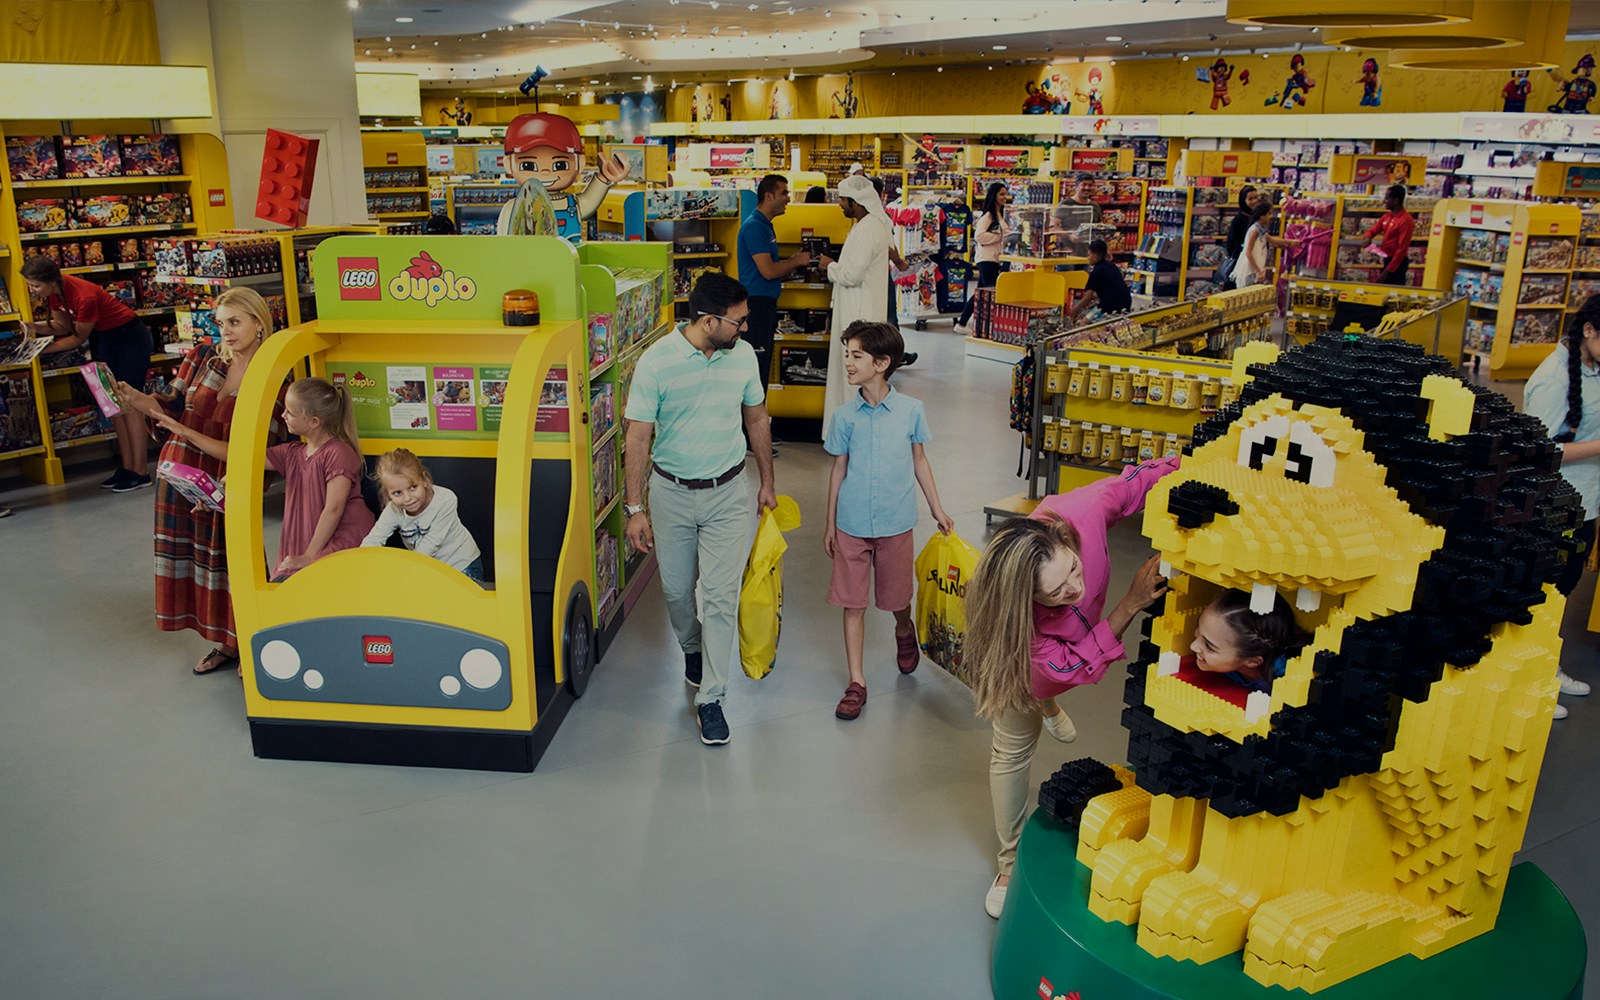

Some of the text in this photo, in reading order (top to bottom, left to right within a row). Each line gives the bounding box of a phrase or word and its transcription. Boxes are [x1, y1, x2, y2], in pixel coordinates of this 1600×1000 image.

[210, 193, 225, 202] LEGO
[342, 270, 477, 307] LEGO duplo
[348, 378, 376, 390] duplo
[366, 643, 392, 656] LEGO
